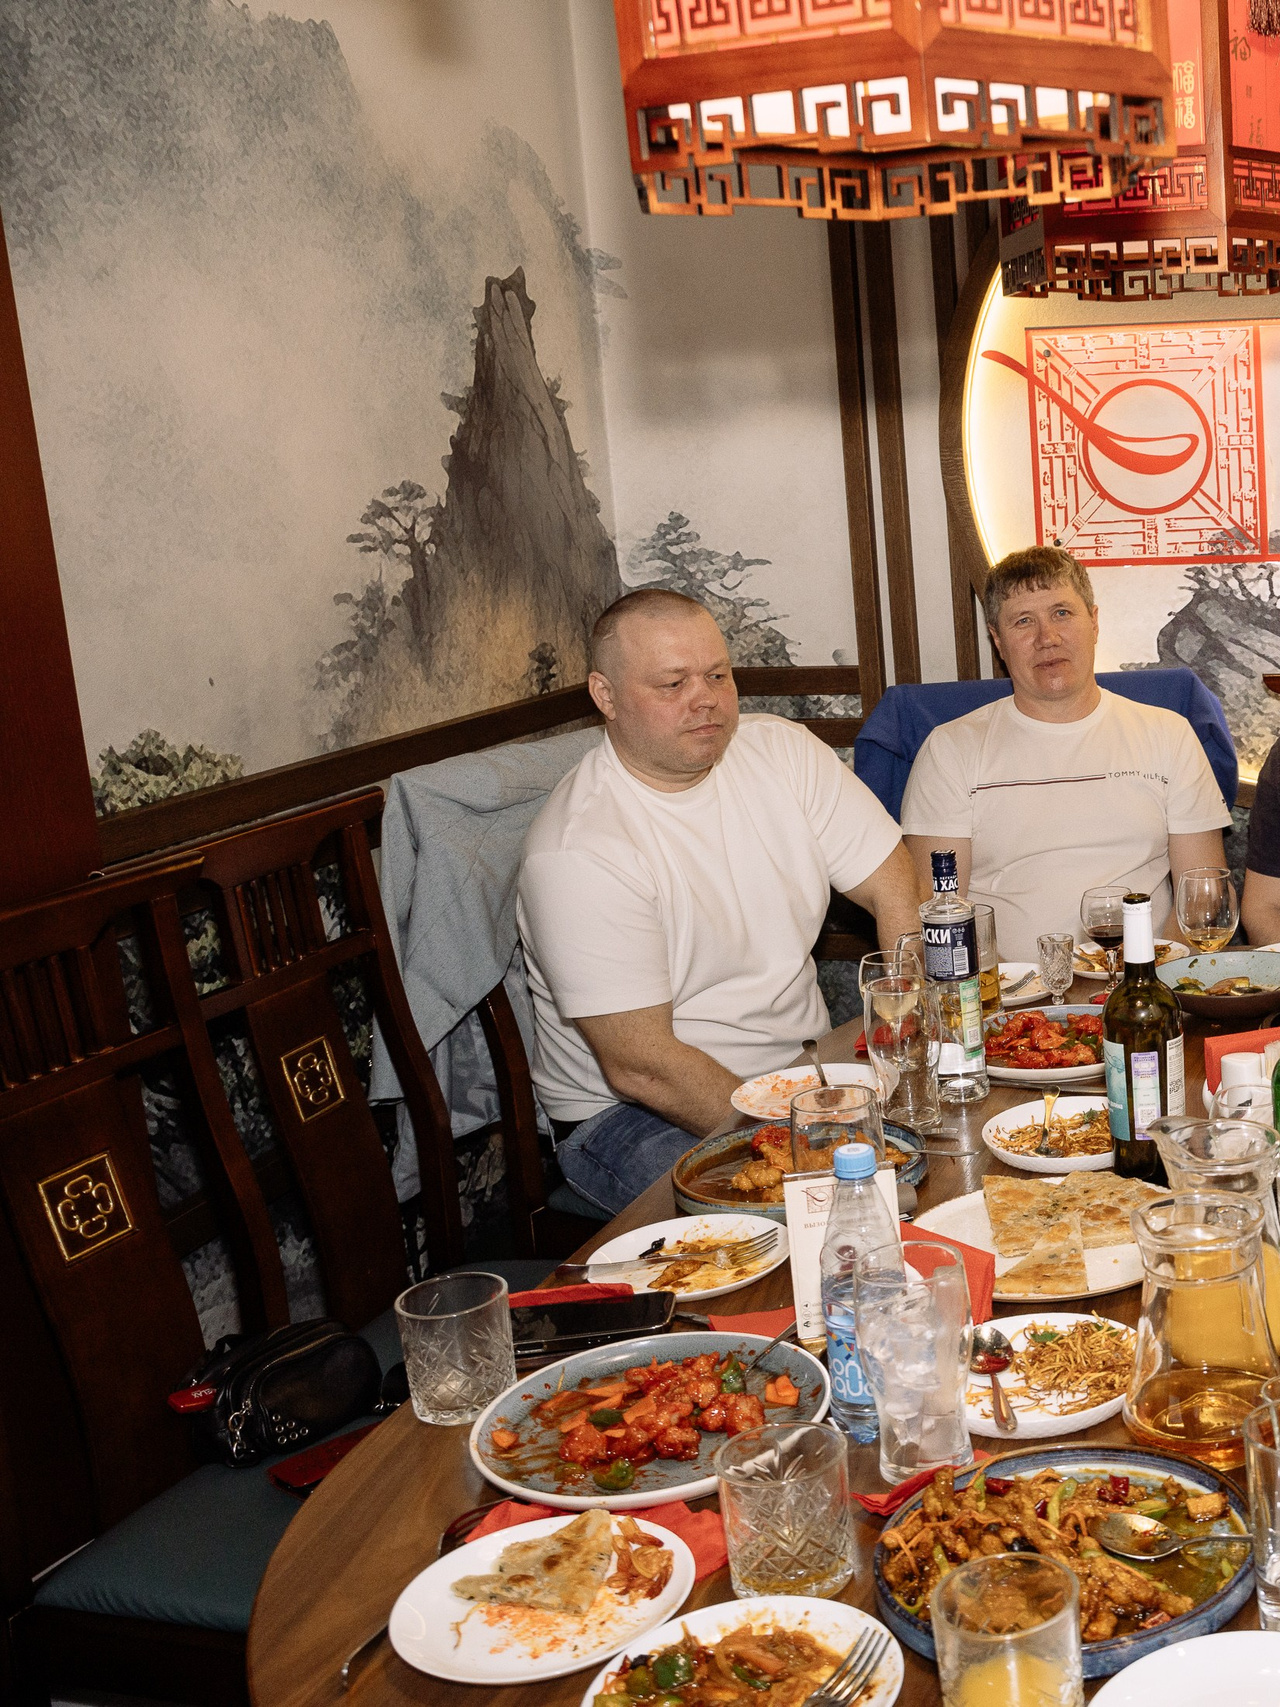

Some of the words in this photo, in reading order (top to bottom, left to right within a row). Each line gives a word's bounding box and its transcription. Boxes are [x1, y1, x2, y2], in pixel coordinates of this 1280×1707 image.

[1108, 770, 1141, 779] TOMMY
[939, 877, 959, 892] ХАС
[803, 1221, 828, 1229] ВЫЗО
